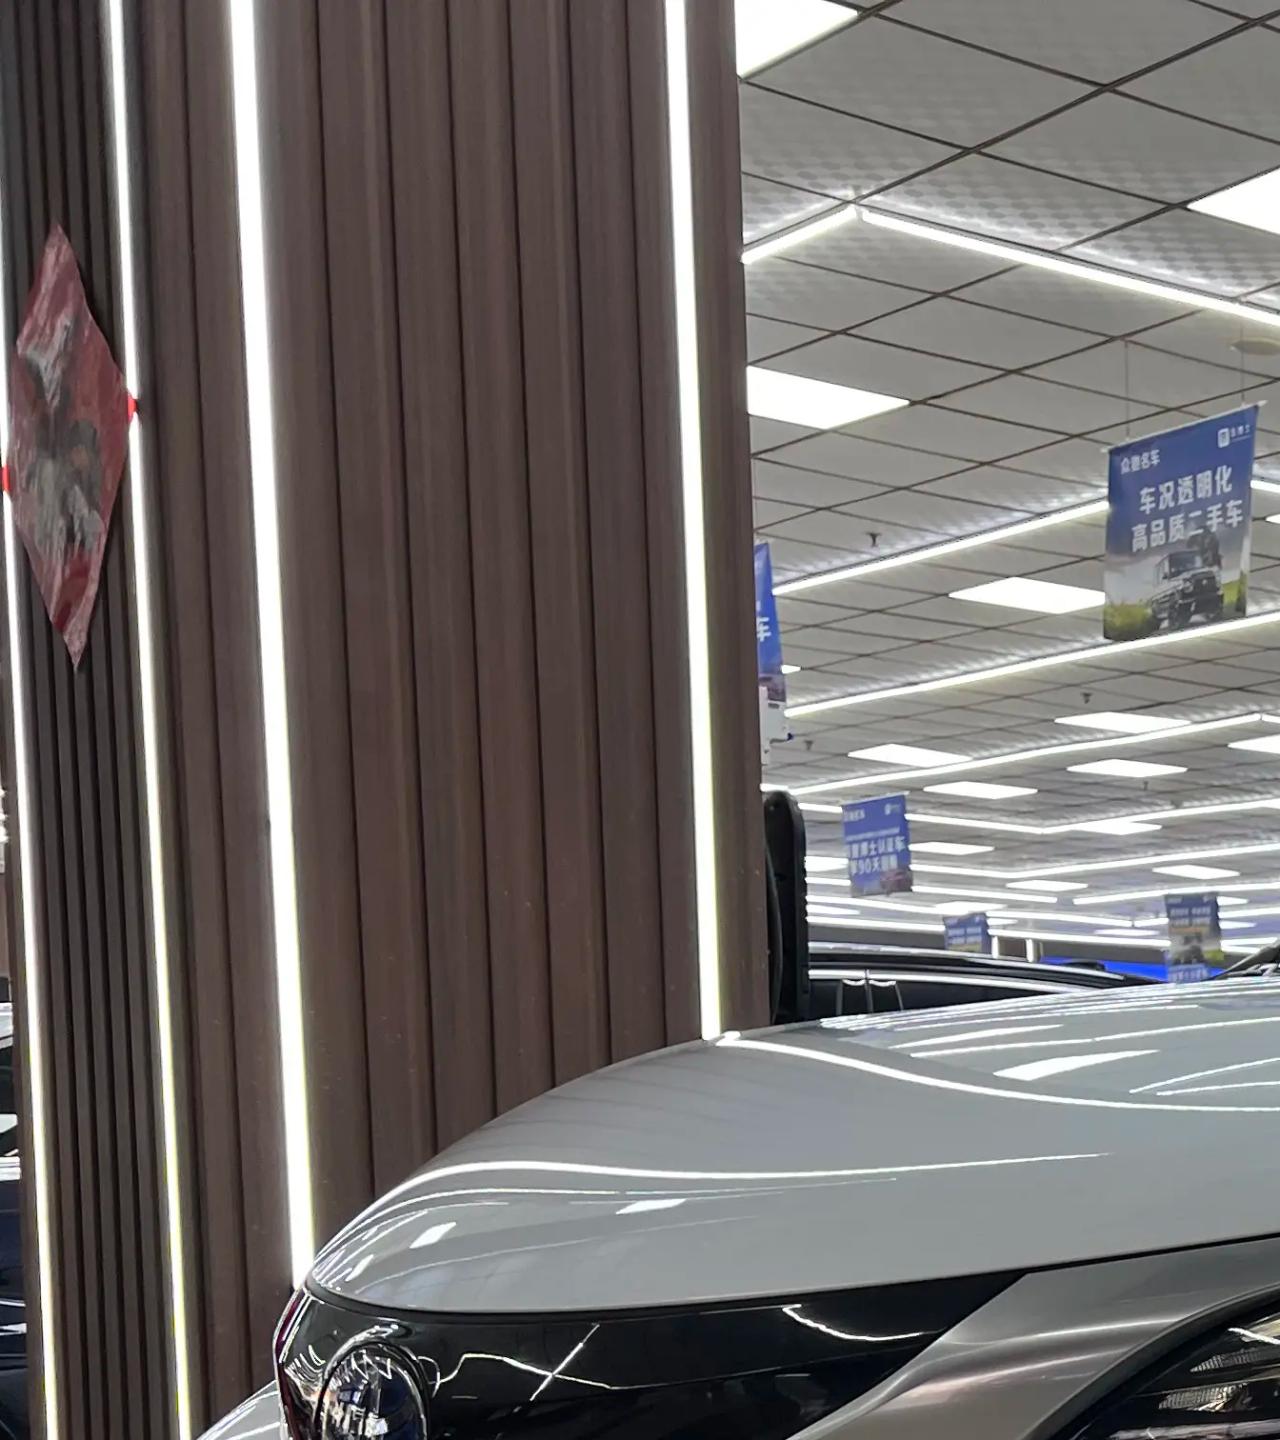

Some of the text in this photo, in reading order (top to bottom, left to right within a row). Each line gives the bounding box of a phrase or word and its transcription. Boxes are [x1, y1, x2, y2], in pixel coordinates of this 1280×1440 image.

[1139, 464, 1233, 515] 车况透明化
[1131, 499, 1244, 553] 高品质二手车
